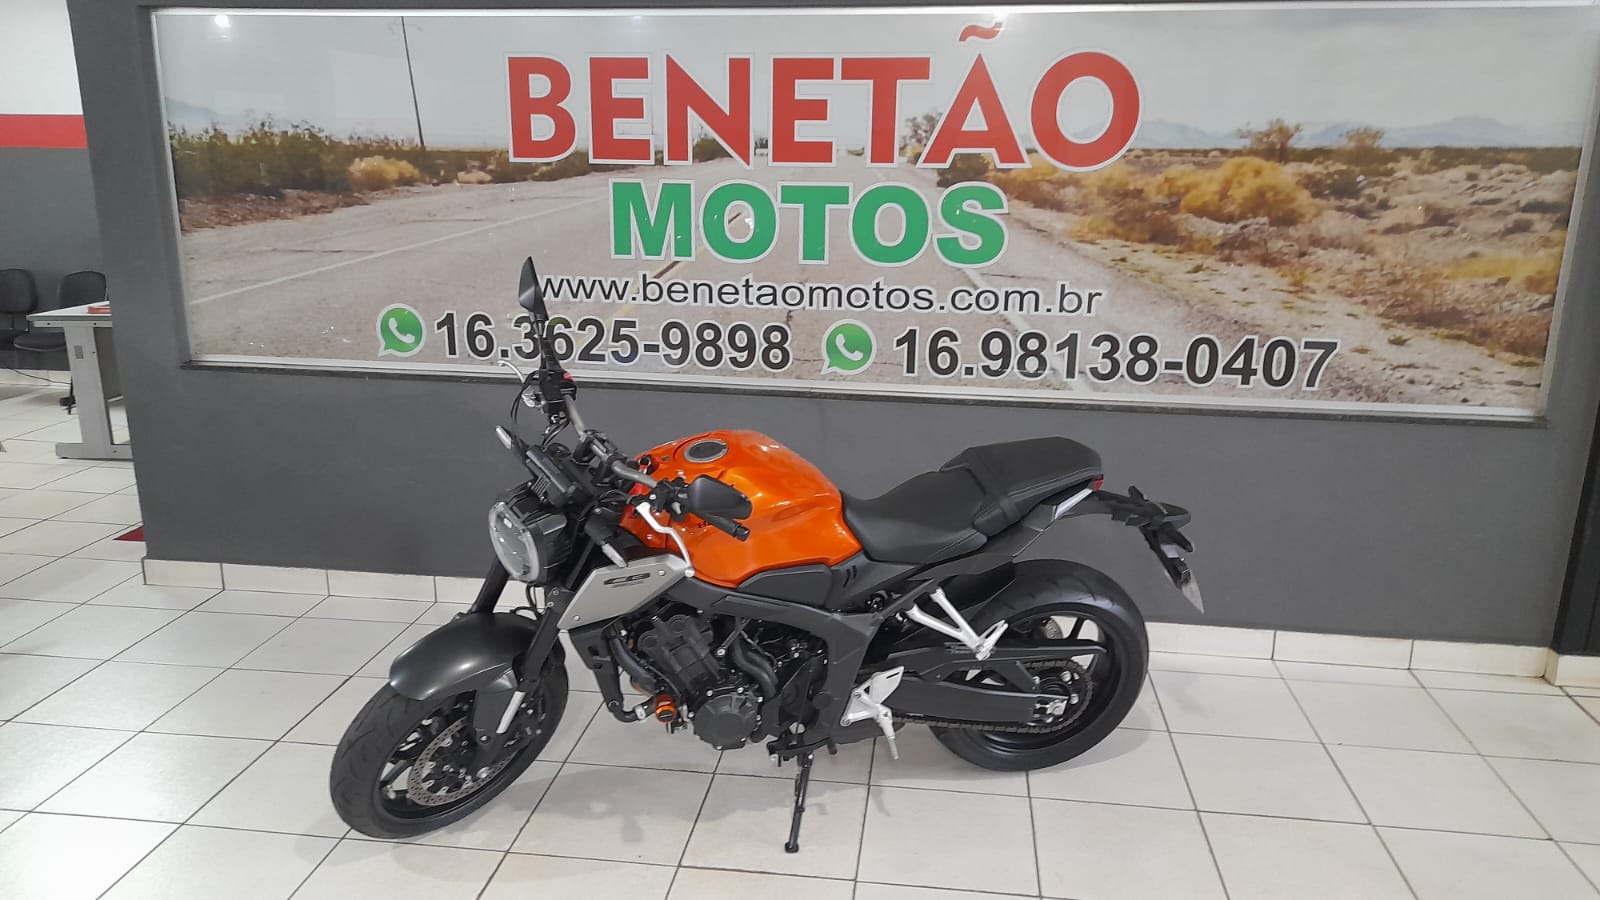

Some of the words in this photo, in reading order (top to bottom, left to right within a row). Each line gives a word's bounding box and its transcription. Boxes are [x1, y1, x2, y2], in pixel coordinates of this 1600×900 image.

[507, 22, 1140, 168] BENETÃO
[610, 182, 1007, 264] MOTOS
[541, 273, 1103, 314] www.benetaomotos.com.br
[437, 312, 791, 370] 16.3625-9898
[895, 328, 1338, 389] 16.98138-0407
